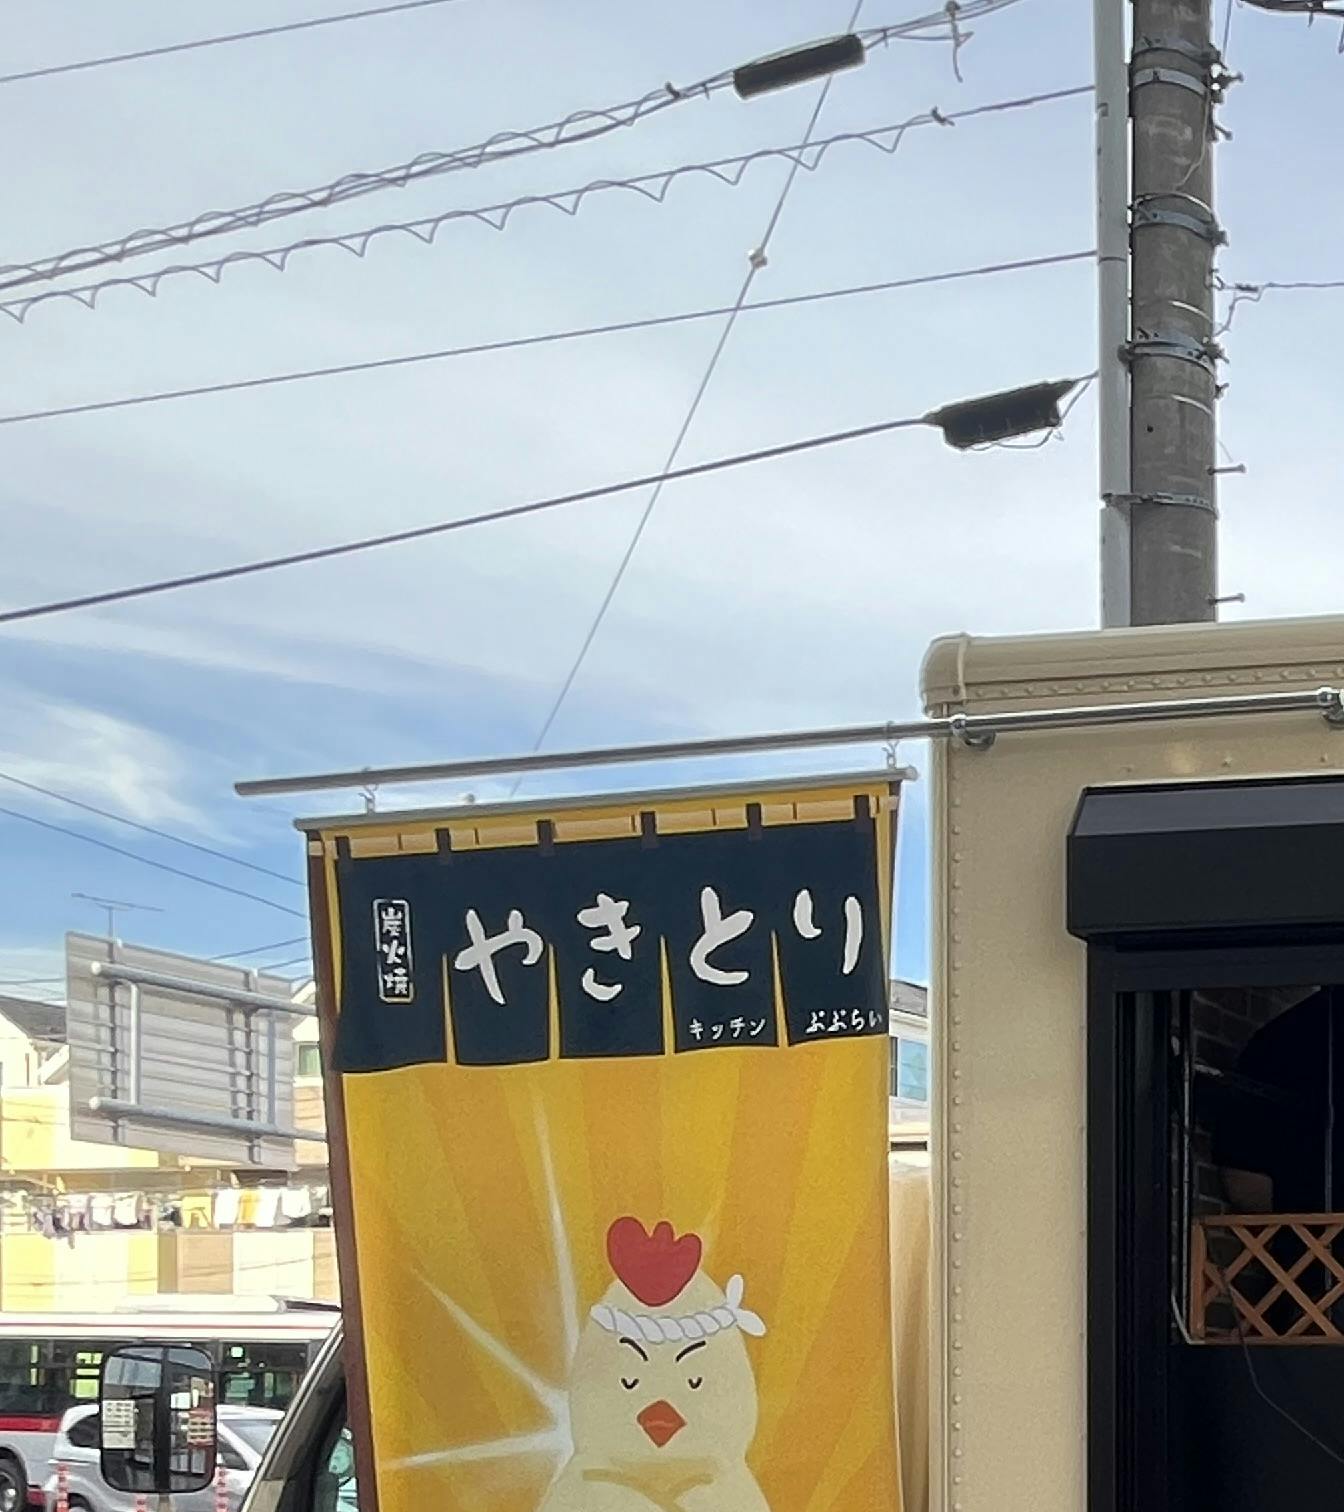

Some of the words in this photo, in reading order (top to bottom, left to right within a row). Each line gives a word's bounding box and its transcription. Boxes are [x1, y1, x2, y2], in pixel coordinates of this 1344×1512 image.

[454, 886, 862, 1004] やきとり
[688, 1016, 767, 1041] キッチン
